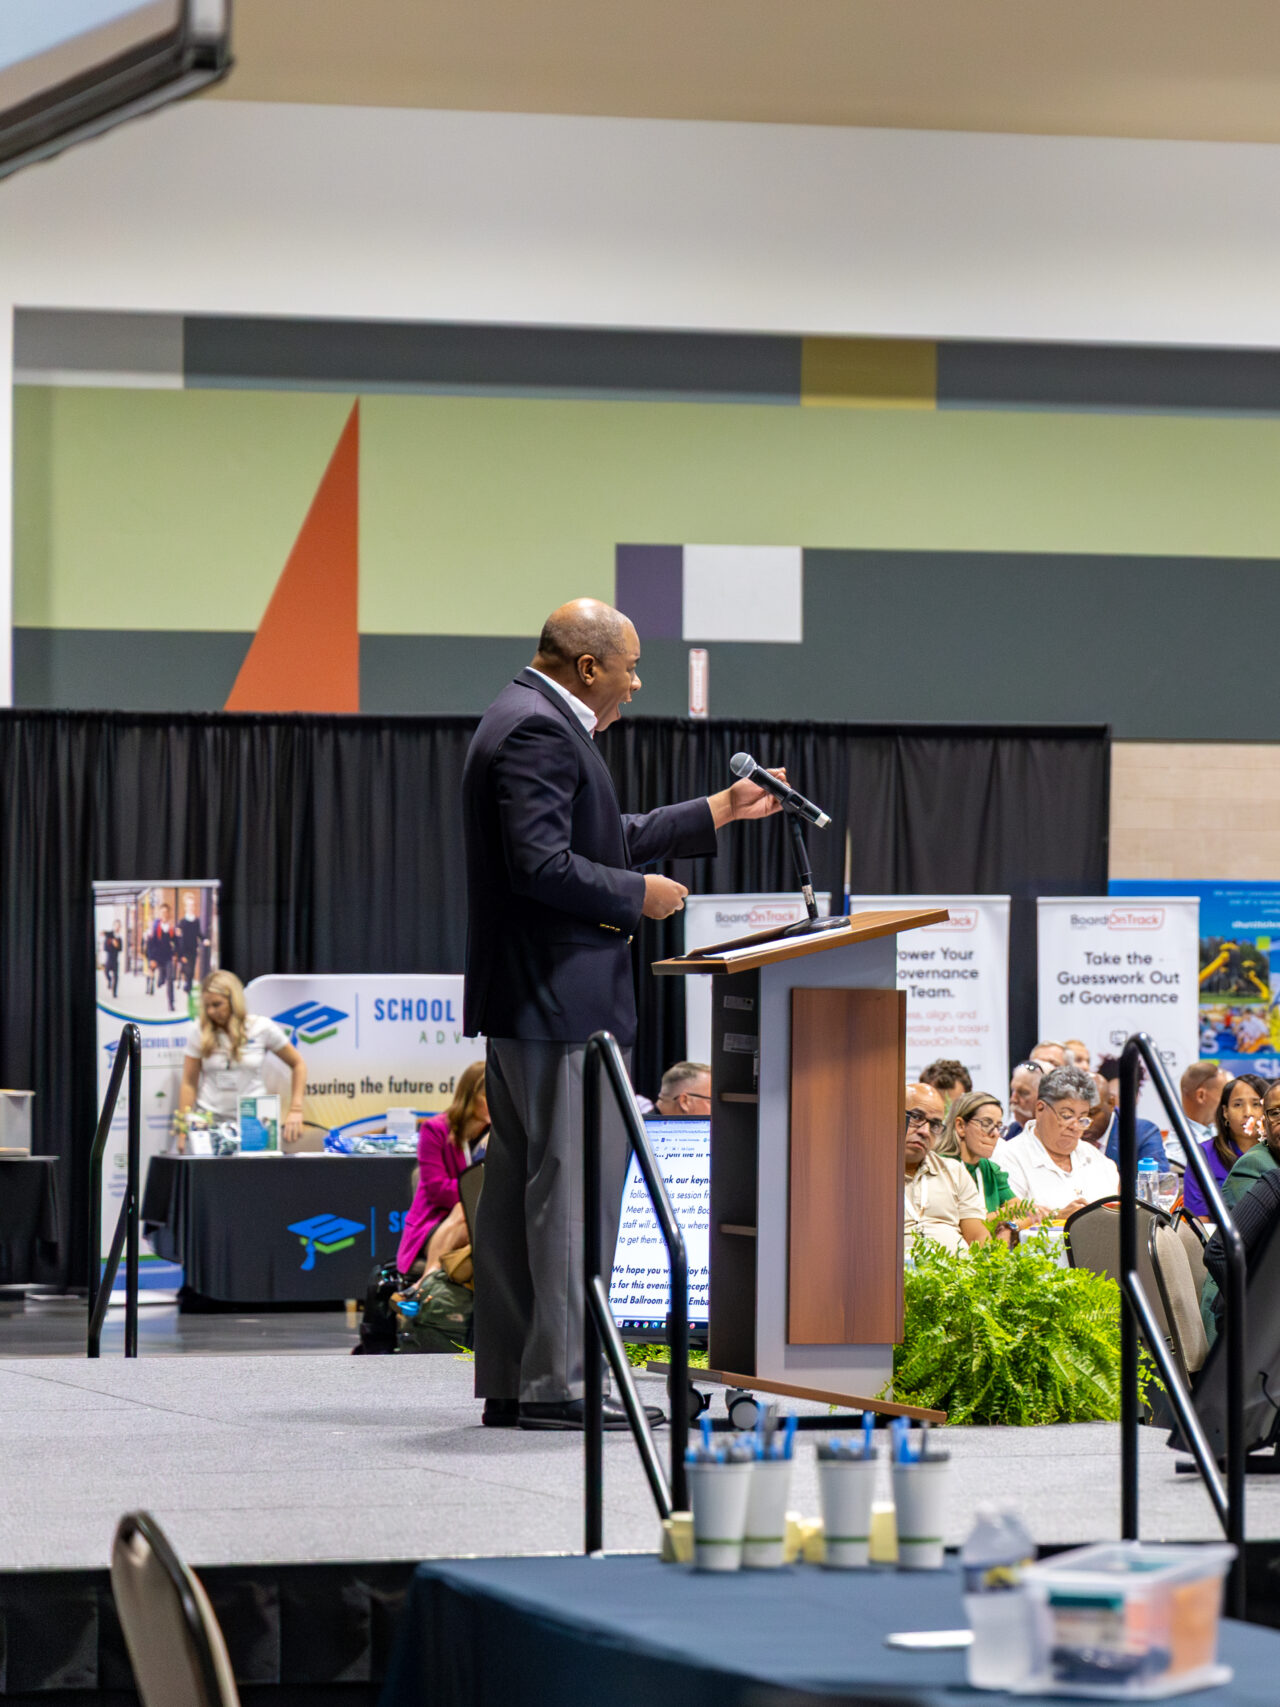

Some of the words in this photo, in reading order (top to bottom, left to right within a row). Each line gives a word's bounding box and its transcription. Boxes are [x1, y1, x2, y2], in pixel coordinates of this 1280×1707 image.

[1070, 913, 1159, 925] BoardOnTrack
[897, 950, 936, 961] ower
[940, 947, 974, 961] Your
[1084, 951, 1121, 965] Take
[1126, 952, 1153, 965] the
[897, 969, 980, 979] overnance
[1057, 971, 1145, 985] Guesswork
[1150, 970, 1180, 985] Out
[910, 985, 956, 998] Team.
[1059, 991, 1075, 1005] of
[1079, 991, 1179, 1005] Governance
[374, 998, 455, 1022] SCHOOL
[303, 1079, 355, 1099] nsuring
[360, 1075, 383, 1094] the
[389, 1075, 434, 1094] future
[438, 1076, 455, 1094] of
[690, 1175, 710, 1186] keyn
[676, 1189, 702, 1199] session
[626, 1206, 644, 1214] Meet
[682, 1205, 696, 1214] with
[622, 1219, 638, 1229] staff
[638, 1219, 651, 1229] will
[687, 1220, 709, 1230] where
[619, 1236, 626, 1244] to
[627, 1237, 640, 1246] get
[640, 1235, 657, 1244] them
[612, 1265, 625, 1273] We
[626, 1265, 645, 1276] hope
[647, 1268, 661, 1276] you
[618, 1280, 629, 1288] for
[631, 1280, 645, 1289] this
[646, 1281, 671, 1290] evenin
[630, 1295, 663, 1305] Ballroom
